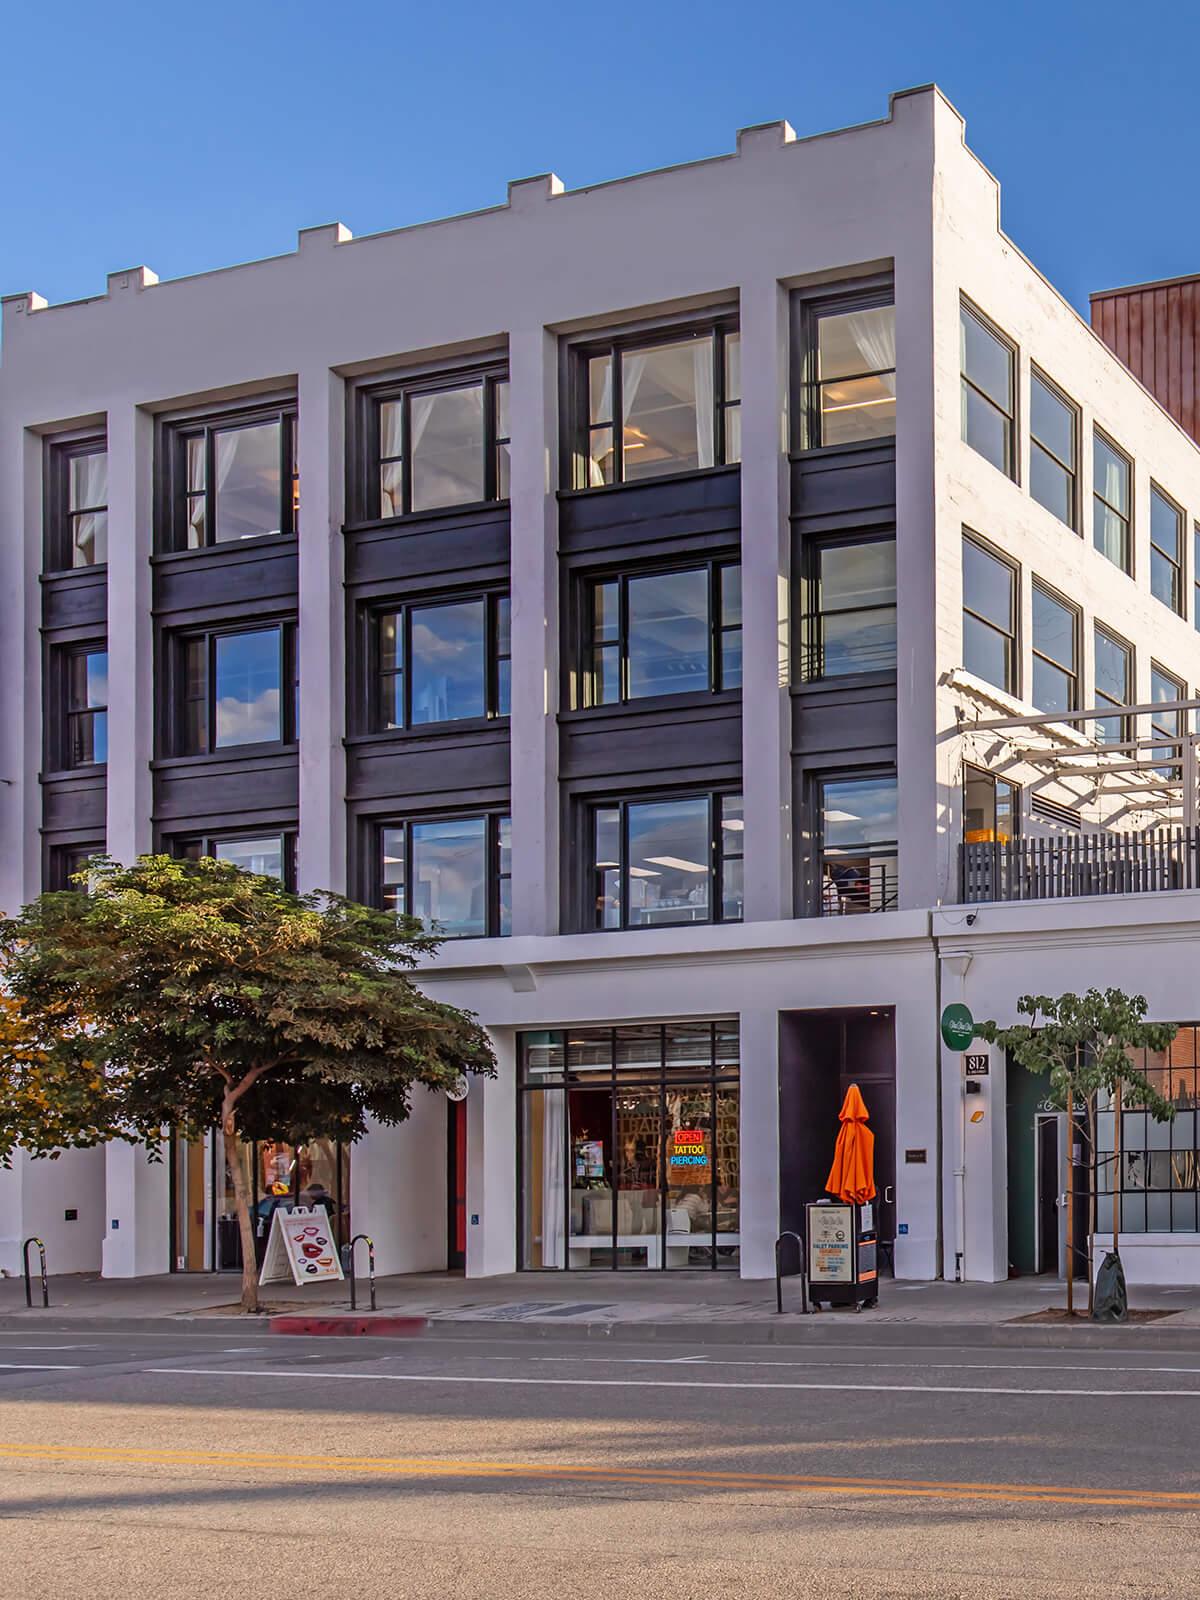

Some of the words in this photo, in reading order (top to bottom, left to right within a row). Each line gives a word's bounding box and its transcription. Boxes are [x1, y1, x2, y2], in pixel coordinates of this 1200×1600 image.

[968, 1056, 986, 1070] 812
[678, 1133, 701, 1141] OPEN
[674, 1145, 704, 1155] TATTOO
[670, 1156, 707, 1165] PIERCING
